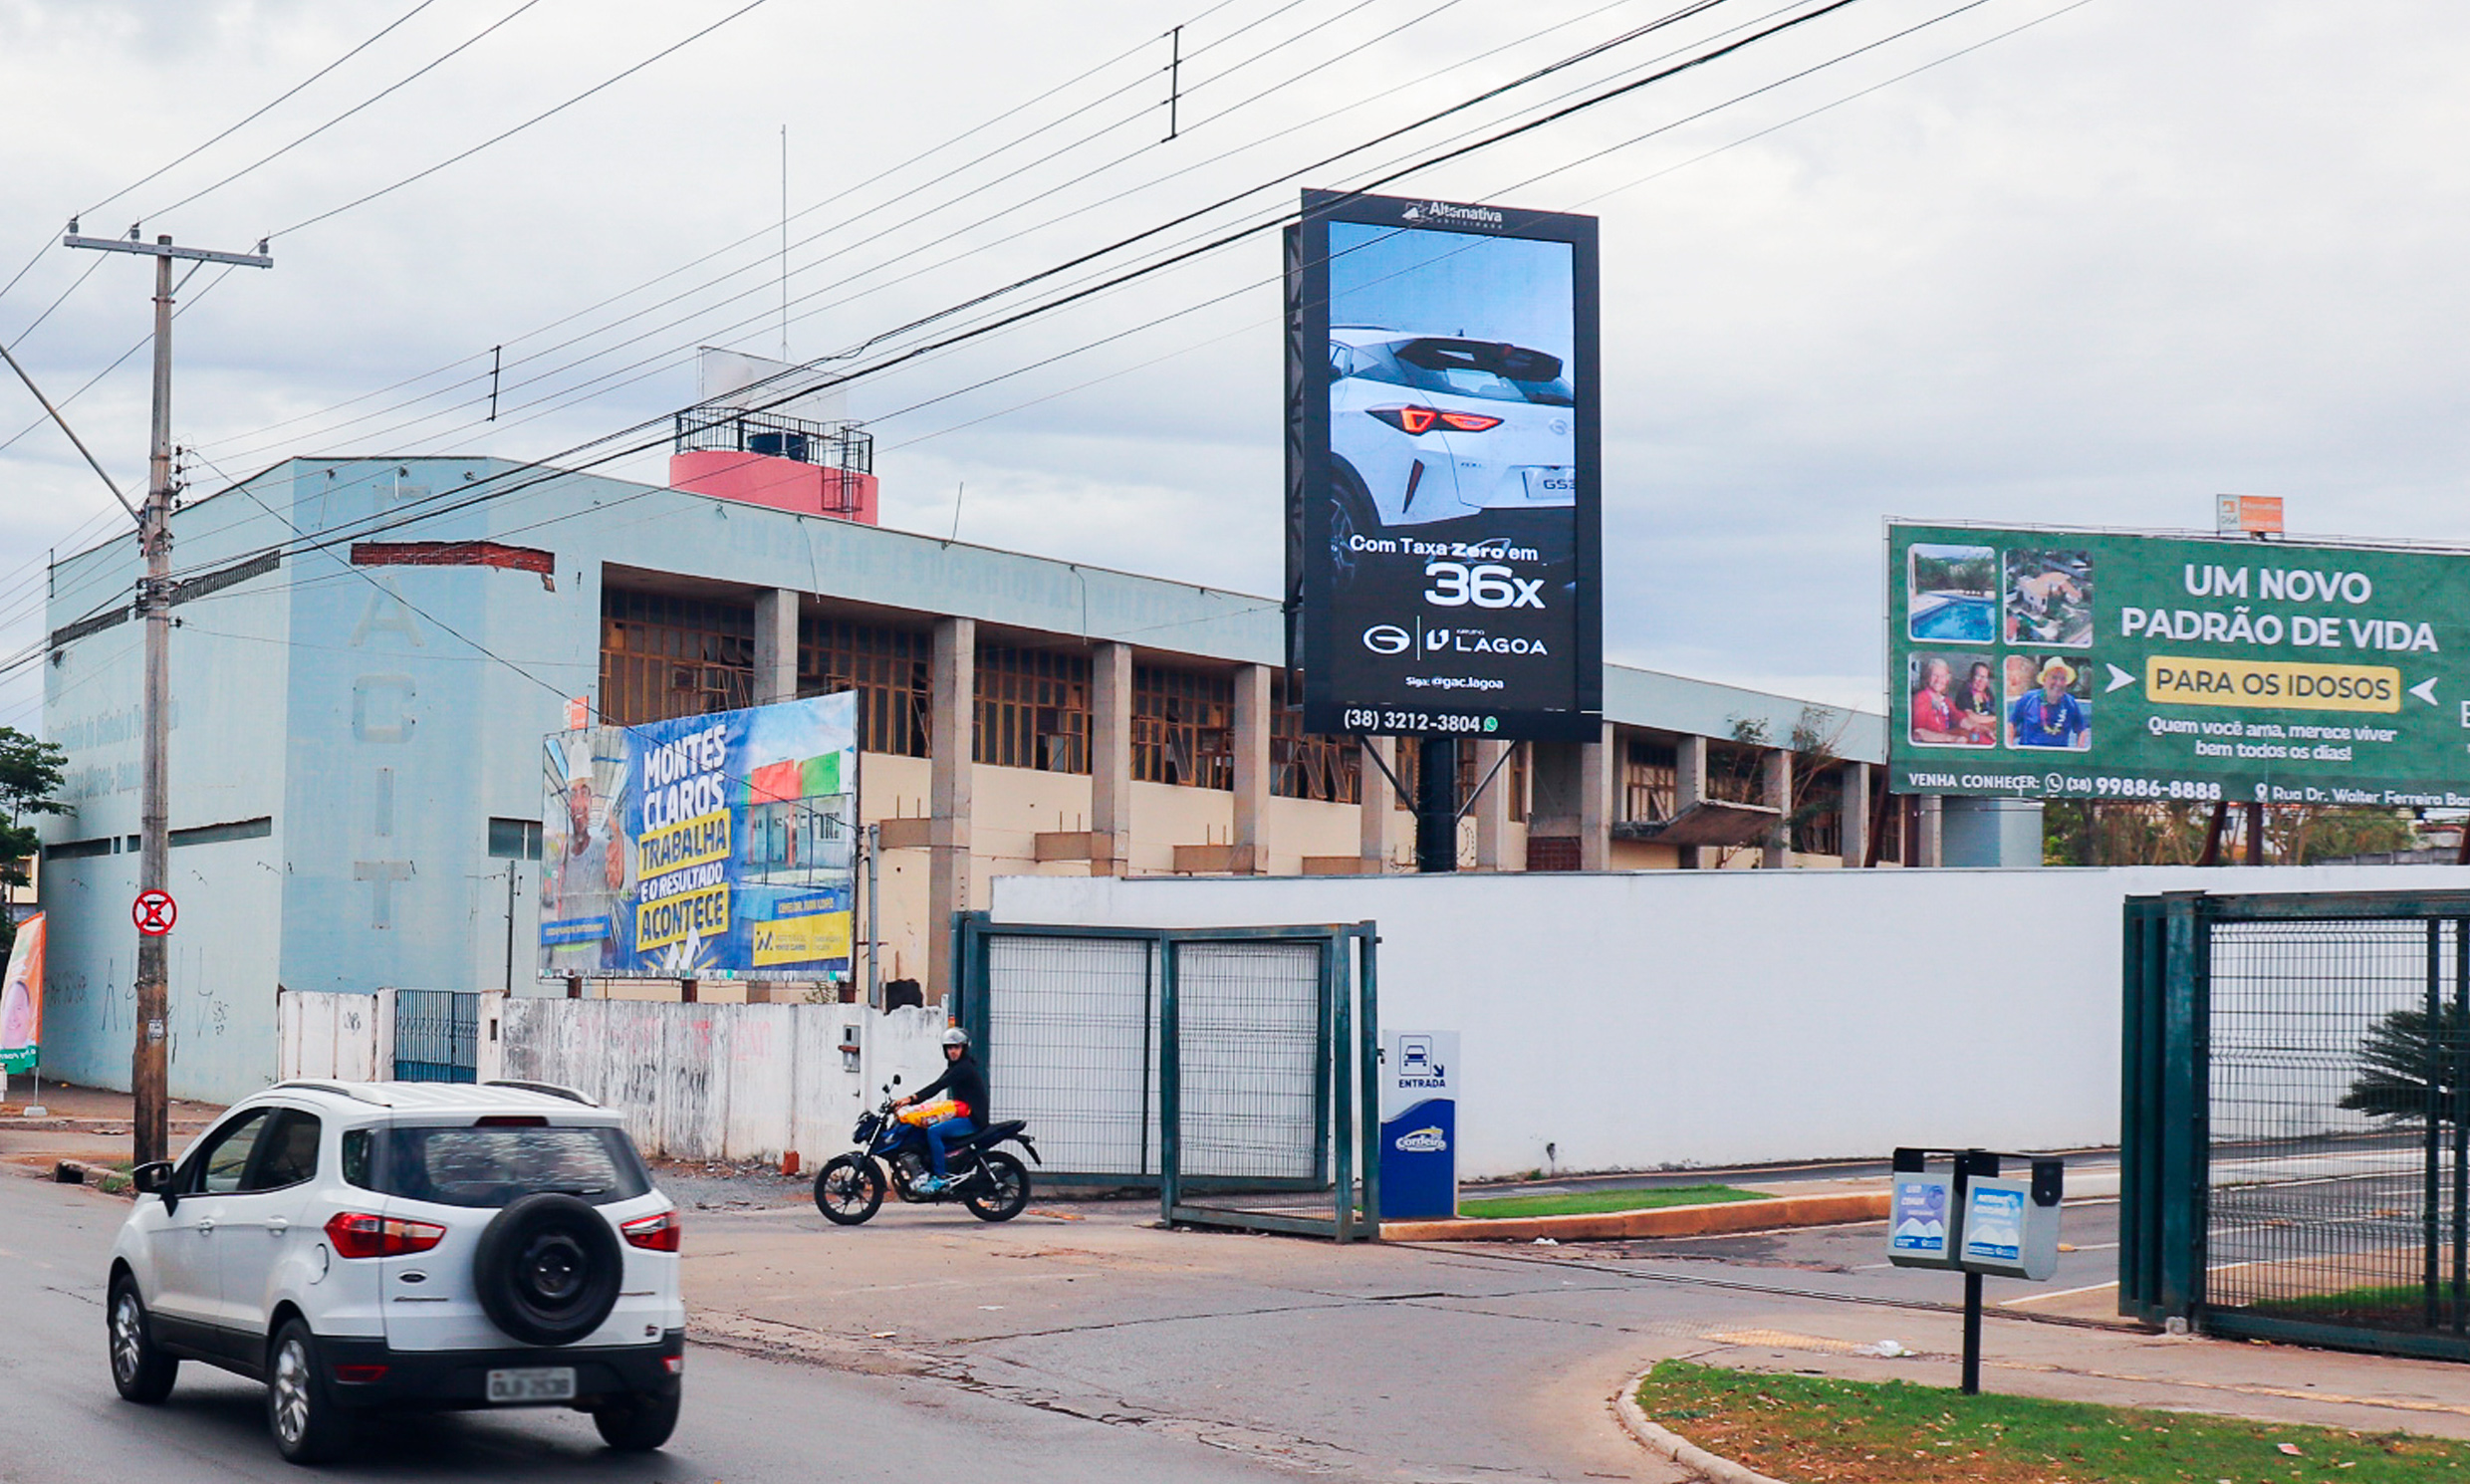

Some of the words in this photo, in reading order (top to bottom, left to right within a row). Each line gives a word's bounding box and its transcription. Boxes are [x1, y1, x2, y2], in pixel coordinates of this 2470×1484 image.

[1350, 535, 1396, 553] Com
[1400, 538, 1447, 556] Taxa
[1451, 542, 1505, 559] Zero
[1509, 546, 1539, 561] em
[1424, 563, 1546, 609] 36x
[2184, 564, 2249, 599] UM
[2260, 568, 2372, 605] NOVO
[2121, 607, 2284, 645] PADRÃO
[2292, 617, 2341, 647] DE
[2347, 619, 2439, 653] VIDA
[1455, 636, 1548, 655] LAGOA
[1431, 676, 1505, 691] @gac.lagoa
[2155, 667, 2235, 694] PARA
[2241, 671, 2280, 697] OS
[2288, 674, 2392, 701] IDOSOS
[1344, 709, 1379, 731] (38)
[1384, 711, 1481, 733] 3212-3804
[2147, 716, 2197, 737] Quem
[2201, 716, 2244, 737] você
[2246, 723, 2286, 740] ama,
[2289, 725, 2351, 740] merece
[2354, 726, 2397, 743] viver
[643, 723, 728, 792] MONTES
[2196, 740, 2233, 757] bem
[2237, 741, 2287, 759] todos
[2290, 747, 2310, 759] os
[2313, 745, 2352, 762] dias!
[643, 770, 725, 833] CLAROS
[1909, 773, 1957, 787] VENHA
[1962, 775, 2040, 790] CONHECER:
[2066, 777, 2092, 792] (38)
[2096, 778, 2222, 800] 99886-8888
[2273, 786, 2303, 801] Rua
[2306, 787, 2329, 802] Dr.
[2333, 789, 2380, 804] Walter
[2384, 791, 2443, 806] Ferreira
[640, 819, 728, 872] TRABALHA
[658, 861, 724, 897] RESULTADO
[640, 890, 725, 943] ACONTECE
[1398, 1079, 1446, 1089] ENTRADA
